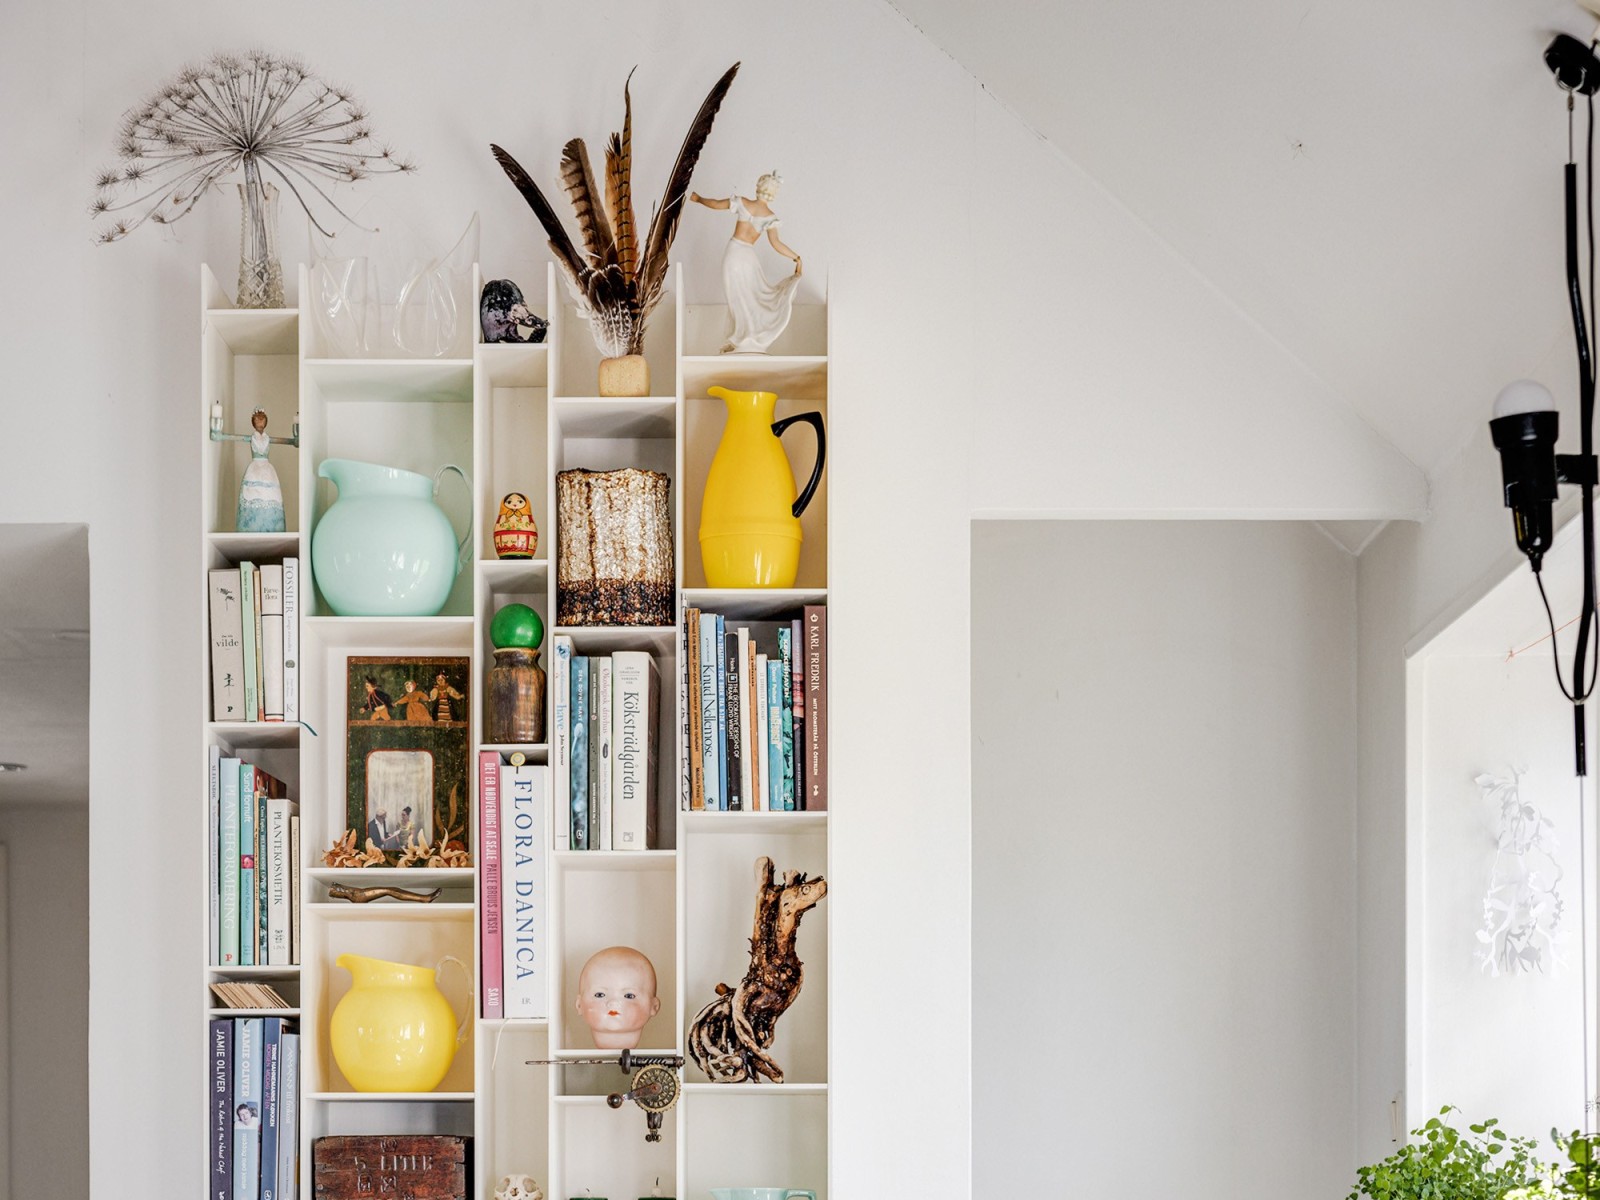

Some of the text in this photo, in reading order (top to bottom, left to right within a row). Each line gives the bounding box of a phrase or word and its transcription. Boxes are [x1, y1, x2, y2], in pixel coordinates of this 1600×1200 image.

[285, 565, 294, 613] FOSSILER
[216, 639, 238, 648] vilde
[810, 626, 819, 692] KARL FREDRIK
[602, 668, 610, 734] Økologisk drivhus
[702, 665, 715, 696] Knud
[556, 705, 567, 730] have
[704, 700, 716, 758] Nellemose
[618, 691, 640, 800] Köksträdgården
[242, 772, 253, 822] Sund fornuft
[224, 784, 235, 929] PLANTEFORMERING
[274, 811, 283, 906] PLANTEKOSMETIK
[485, 763, 499, 935] DET ER NØDVENDIGT AT SEJLE PALLE BRUUS JENSEN
[514, 780, 534, 980] FLORA DANICA
[488, 988, 499, 1006] SAXO
[216, 1029, 225, 1057] JAMIE
[240, 1027, 251, 1098] JAMIE OLIVER
[216, 1060, 225, 1092] OLIVER
[285, 1100, 293, 1125] frokost
[216, 1160, 225, 1174] Chef
